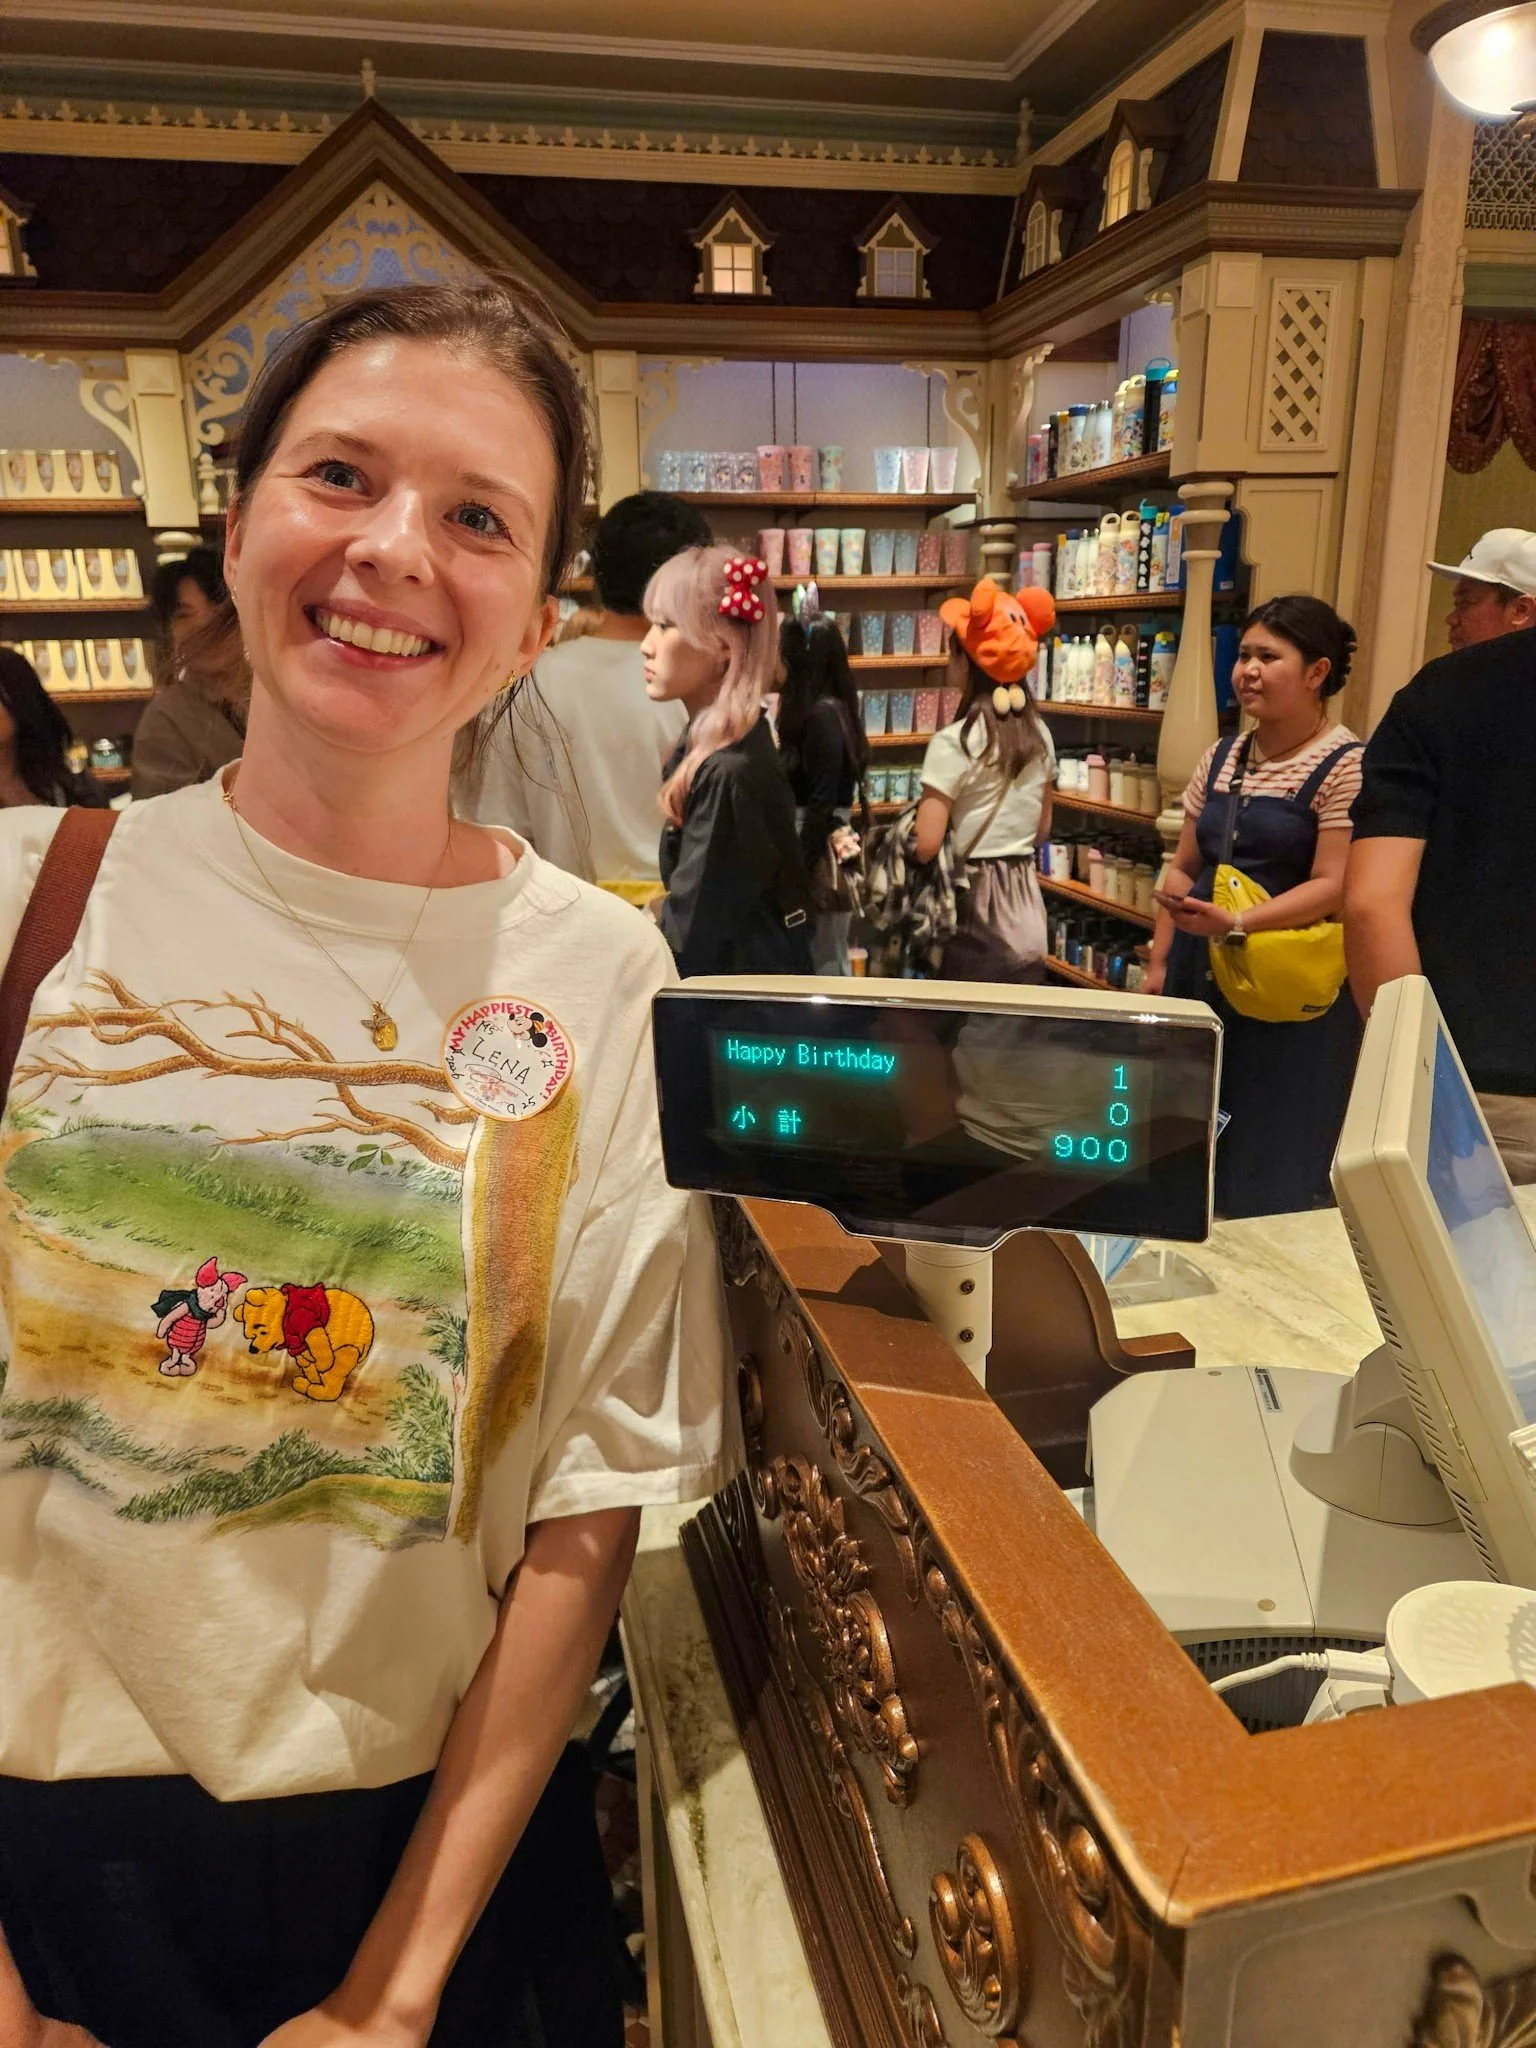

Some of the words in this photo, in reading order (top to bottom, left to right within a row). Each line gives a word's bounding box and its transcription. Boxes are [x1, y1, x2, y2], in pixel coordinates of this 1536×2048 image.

[450, 1027, 466, 1052] MY
[460, 1002, 534, 1029] HAPPIEST
[545, 1028, 569, 1100] BIRTHDAY!
[472, 1036, 531, 1084] LENA
[727, 1038, 786, 1066] Happy
[797, 1043, 896, 1074] Birthday
[1113, 1065, 1128, 1090] 1
[1109, 1102, 1129, 1126] 0
[1054, 1134, 1128, 1163] 900
